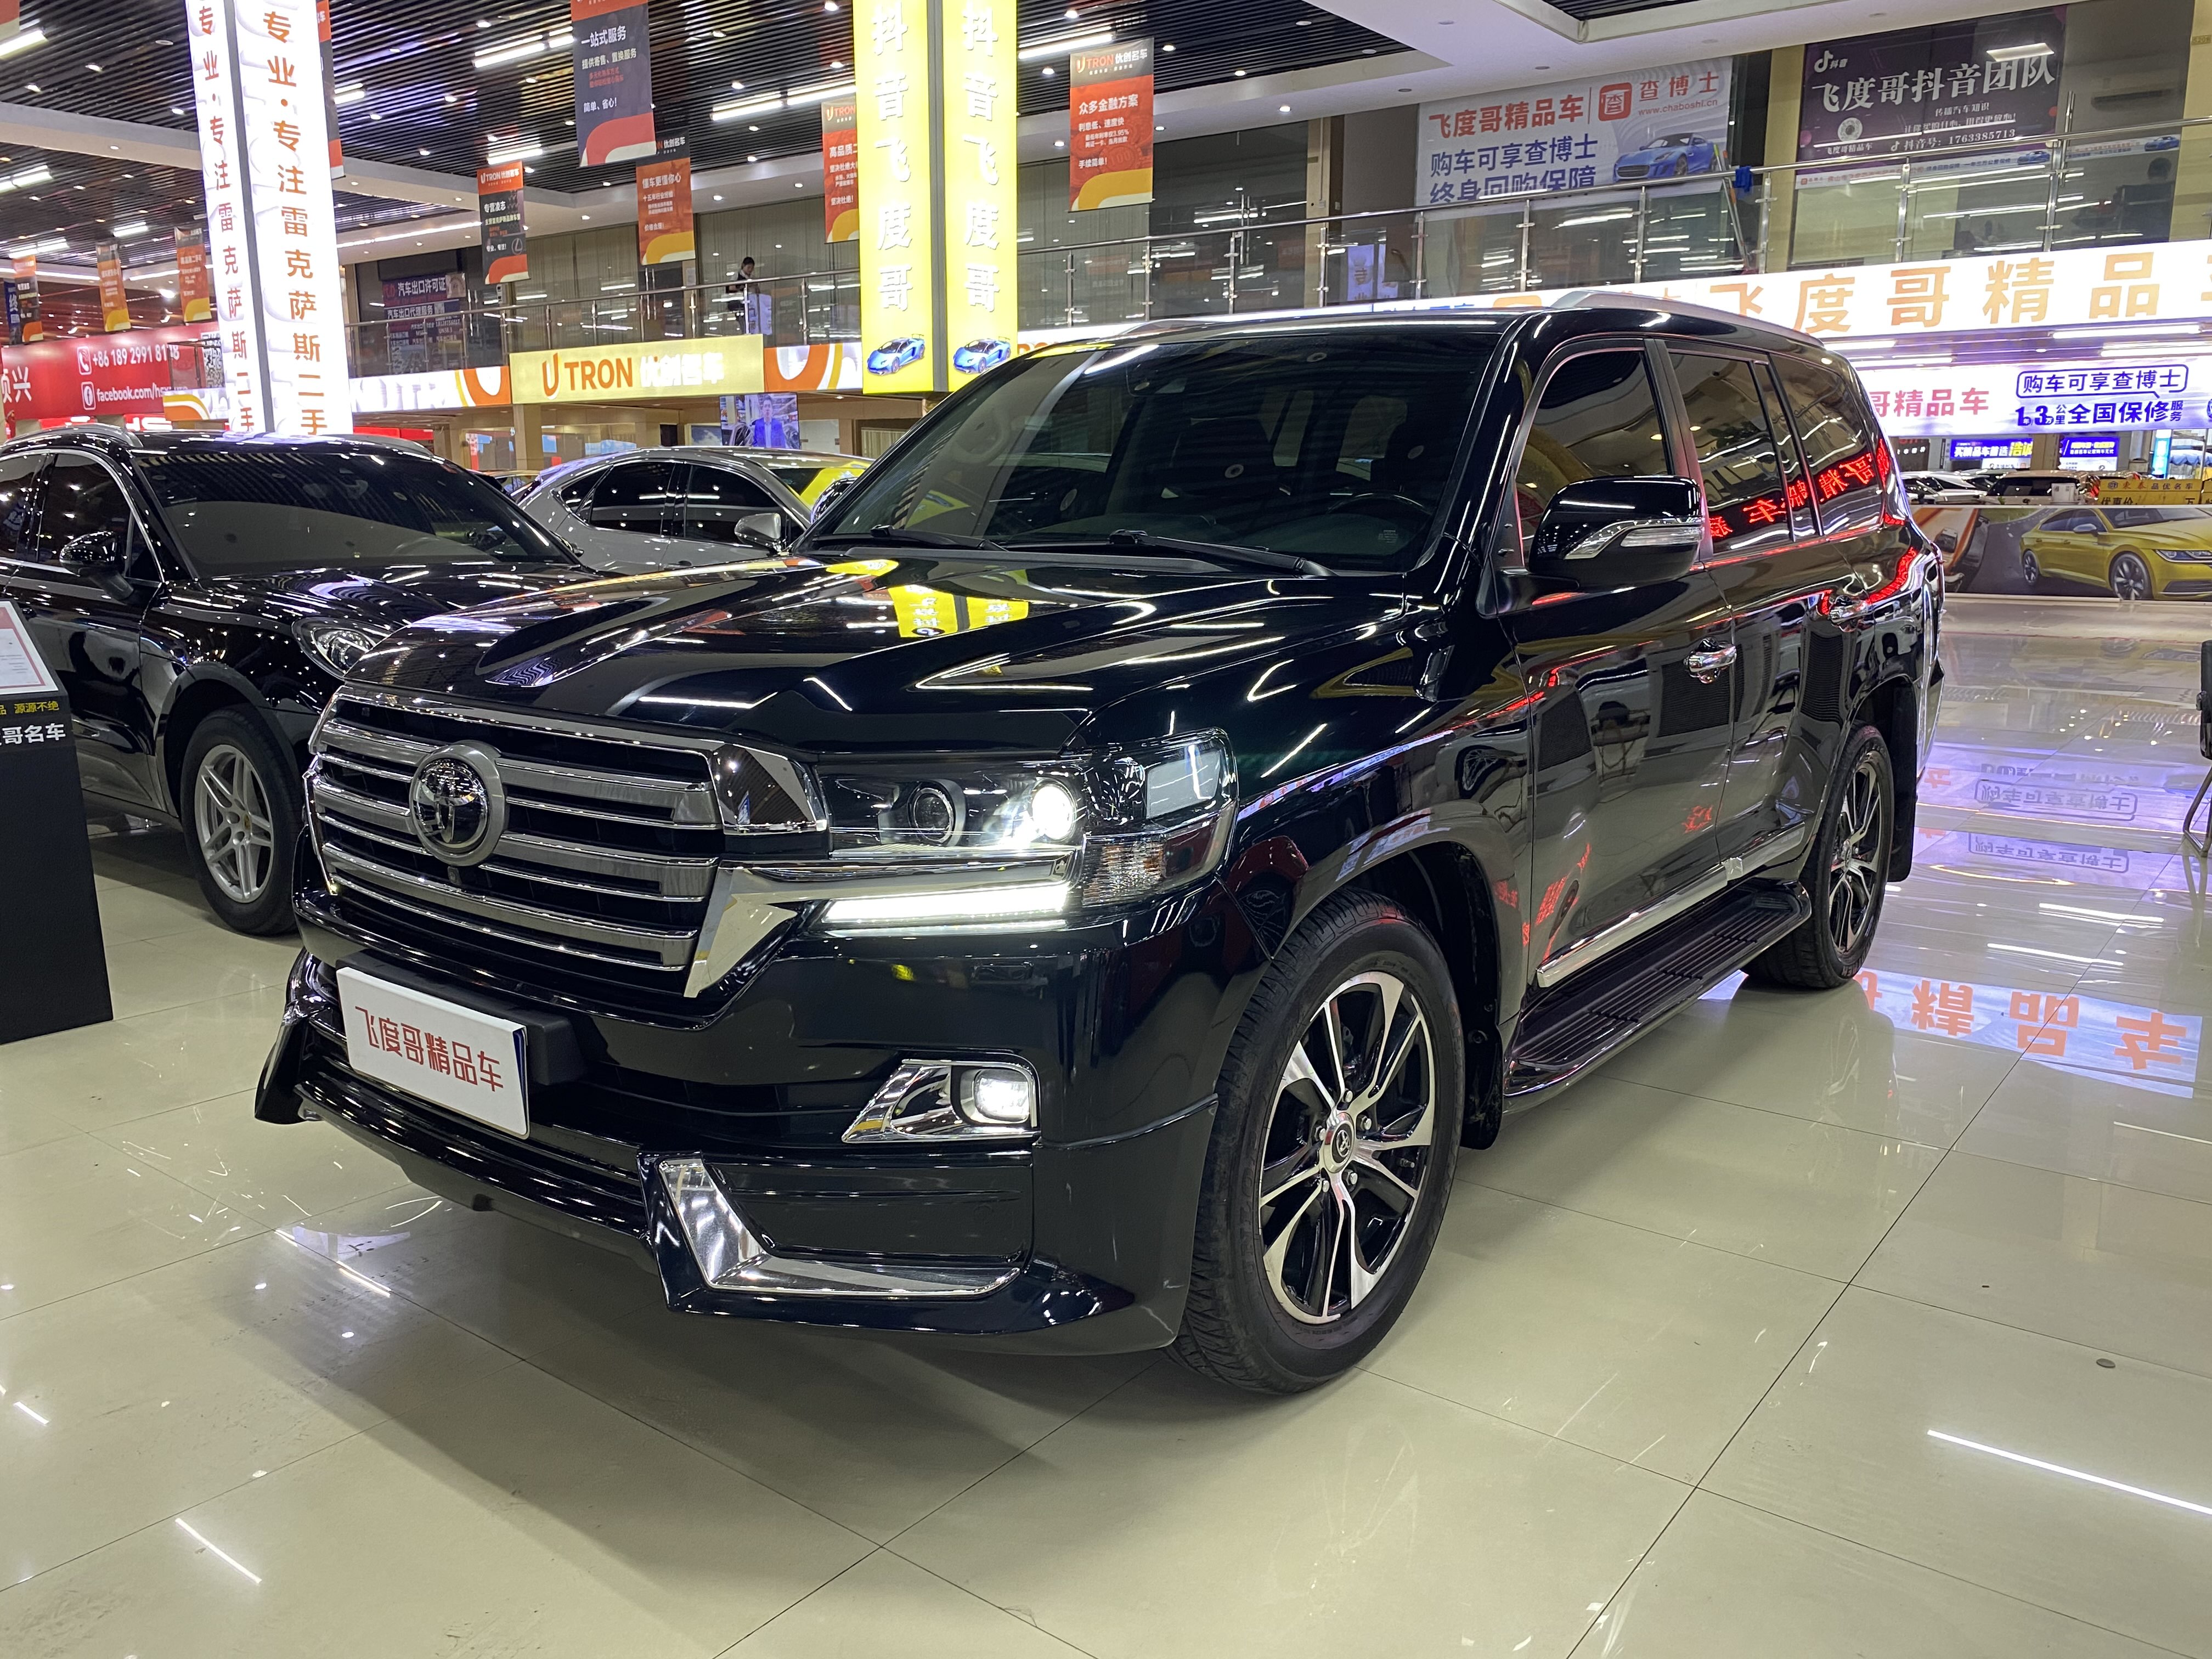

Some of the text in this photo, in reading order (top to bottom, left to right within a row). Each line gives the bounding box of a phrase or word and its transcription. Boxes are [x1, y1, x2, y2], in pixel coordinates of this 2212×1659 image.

[581, 25, 627, 48] 一站式服务
[1639, 72, 1719, 102] 查博士
[1812, 55, 2056, 113] 飞度哥抖音团队
[1079, 94, 1138, 115] 众多金融方案
[1638, 98, 1718, 116] www.chaboshi.cn
[1429, 95, 1584, 139] 飞度哥精品车
[1949, 129, 2016, 144] 1763385713
[1431, 133, 1598, 177] 购车可享查博士
[398, 277, 446, 297] 汽车出口许可证
[93, 352, 110, 369] +86
[111, 348, 127, 366] 189
[131, 347, 153, 364] 2991
[542, 352, 633, 399] UTRON
[2023, 366, 2182, 394] 购车可享查博士
[14, 701, 59, 713] 源源不绝
[0, 723, 66, 745] 哥名车
[355, 1006, 504, 1092] 飞度哥精品车
